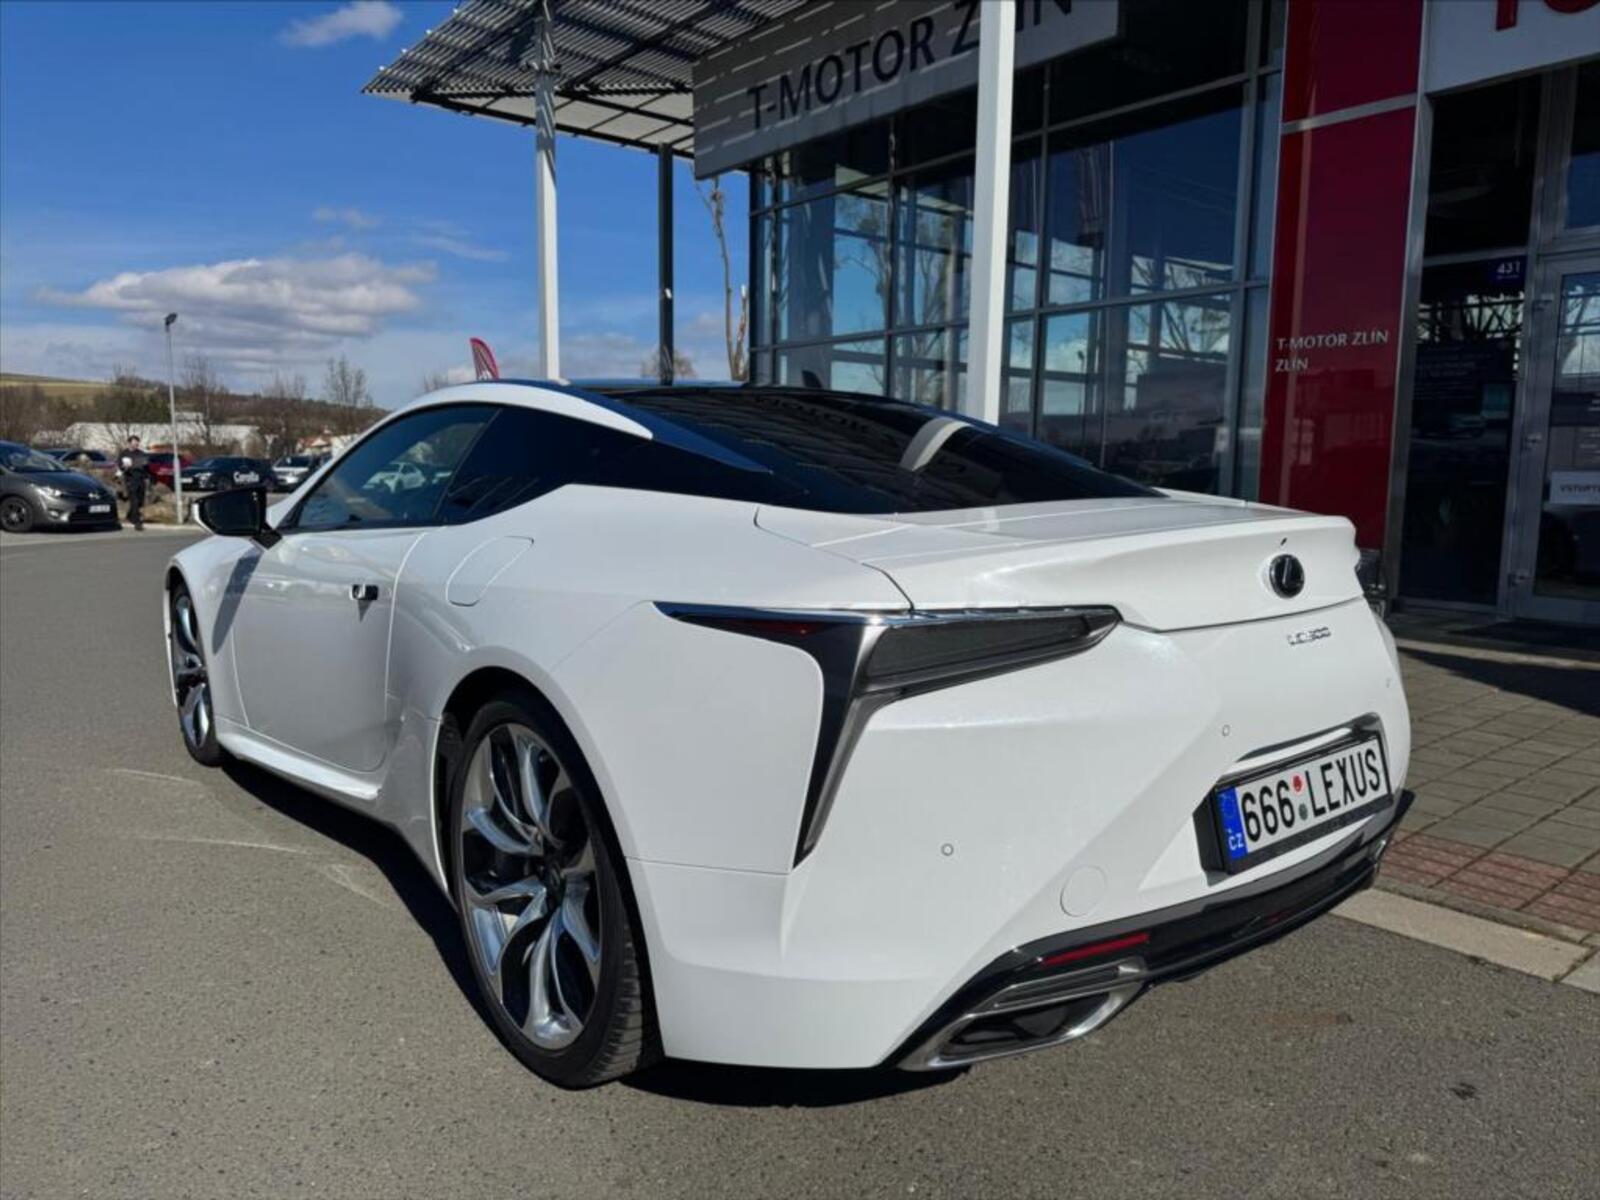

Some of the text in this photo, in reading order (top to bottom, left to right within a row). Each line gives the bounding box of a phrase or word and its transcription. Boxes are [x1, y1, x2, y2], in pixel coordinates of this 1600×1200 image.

[747, 16, 935, 130] T-MOTOR
[1277, 332, 1348, 351] T-MOTOR
[1241, 748, 1381, 842] 666 LEXUS
[1228, 833, 1245, 851] CZ
